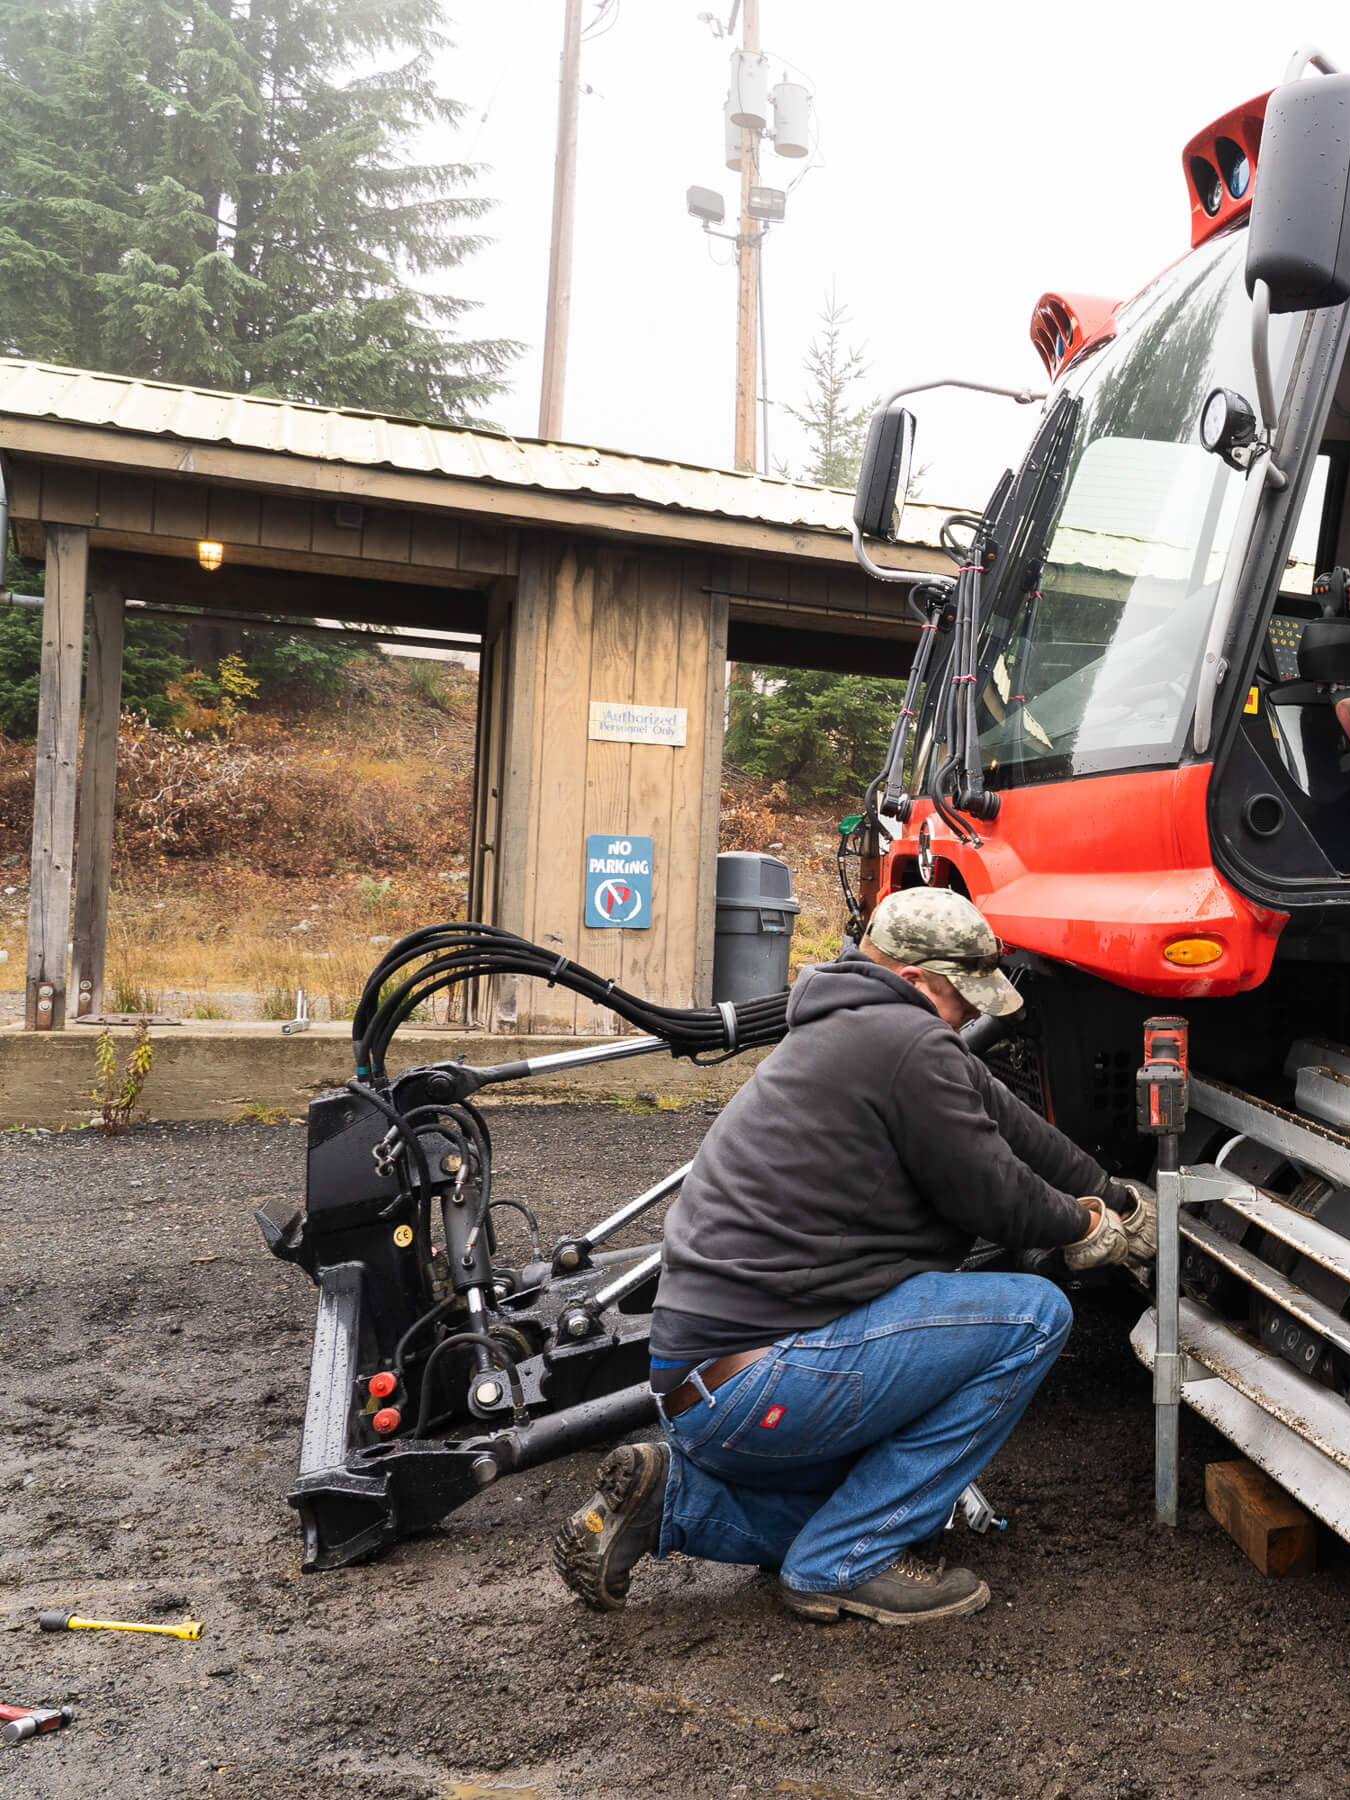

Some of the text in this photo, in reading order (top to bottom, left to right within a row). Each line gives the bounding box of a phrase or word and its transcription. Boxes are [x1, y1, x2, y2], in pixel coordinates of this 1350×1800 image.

[604, 709, 677, 726] Authorized
[599, 721, 675, 736] Personnel Only
[608, 841, 632, 855] NO
[589, 858, 649, 874] PARKING
